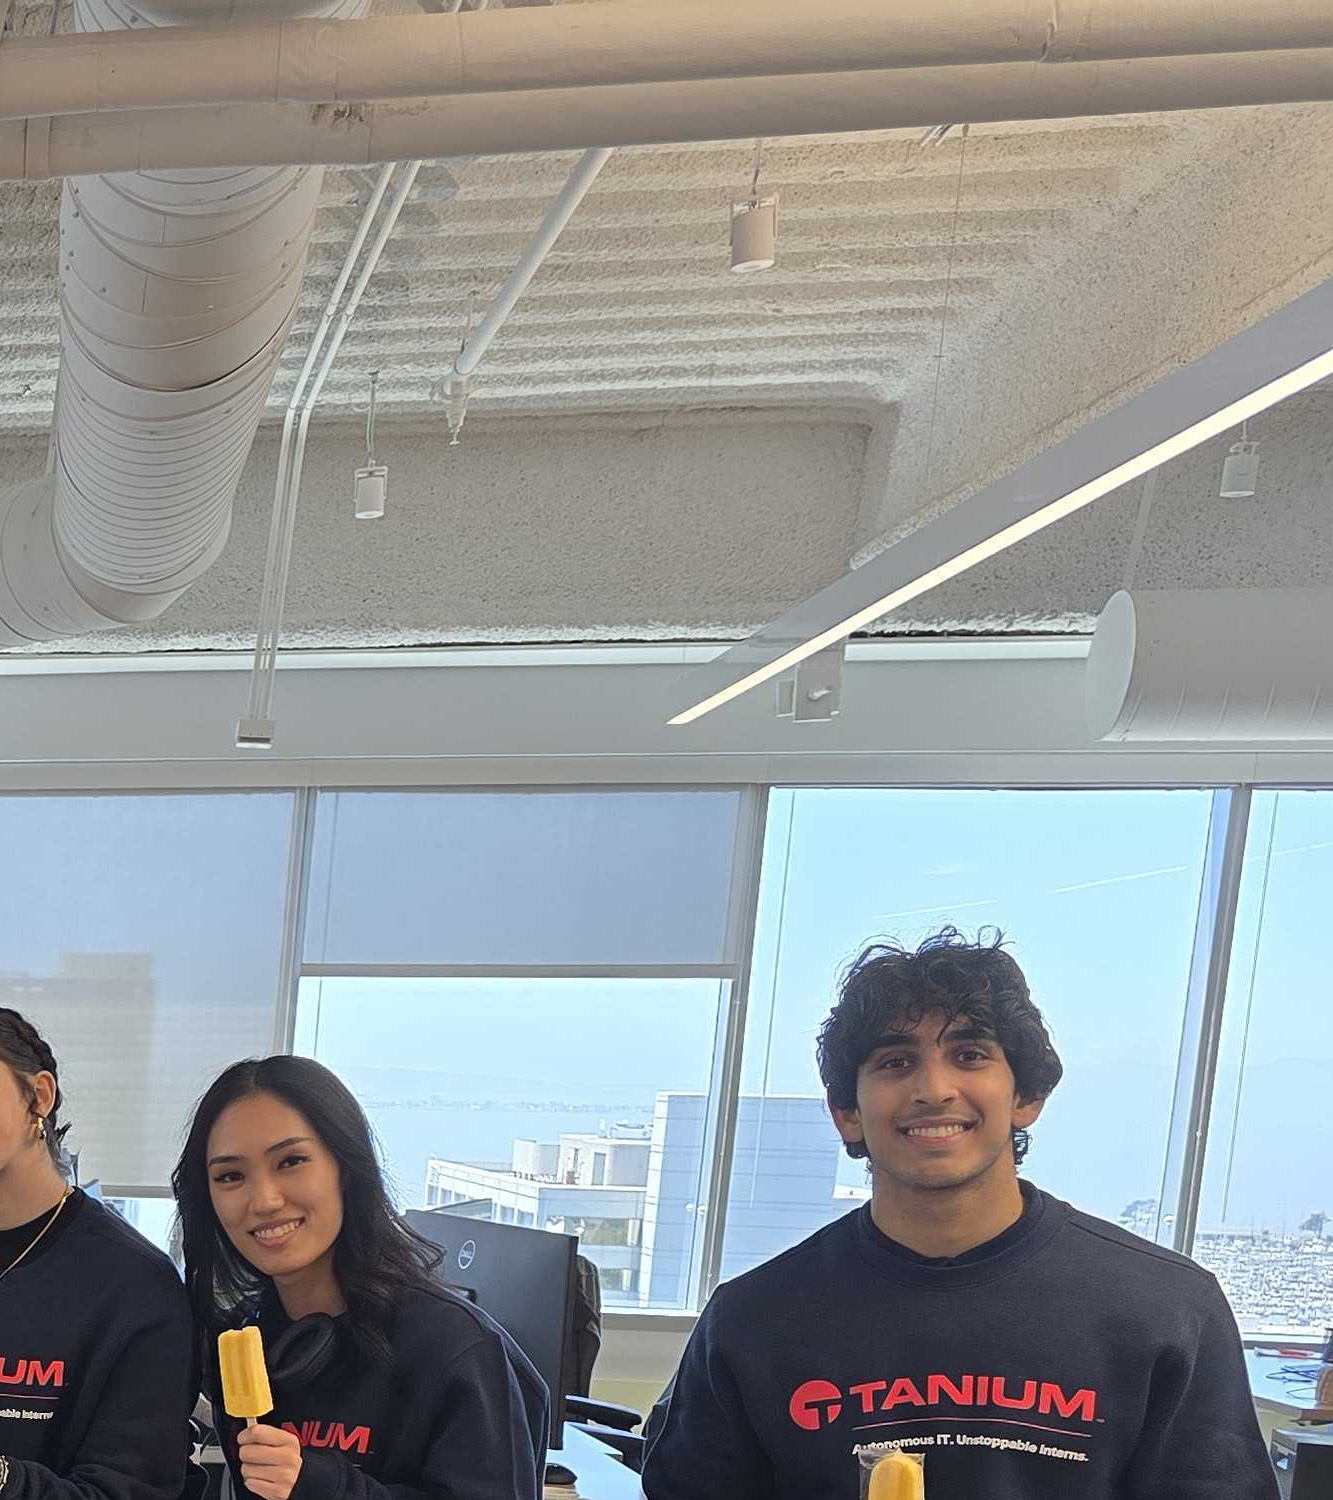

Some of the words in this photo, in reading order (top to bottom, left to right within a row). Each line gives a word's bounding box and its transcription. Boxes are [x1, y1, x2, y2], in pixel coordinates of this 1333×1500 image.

[849, 1375, 1097, 1422] TANIUM
[852, 1434, 935, 1455] Autonomous
[936, 1433, 955, 1446] IT.
[956, 1433, 1037, 1454] Unstoppable
[1038, 1443, 1090, 1463] Interns.
